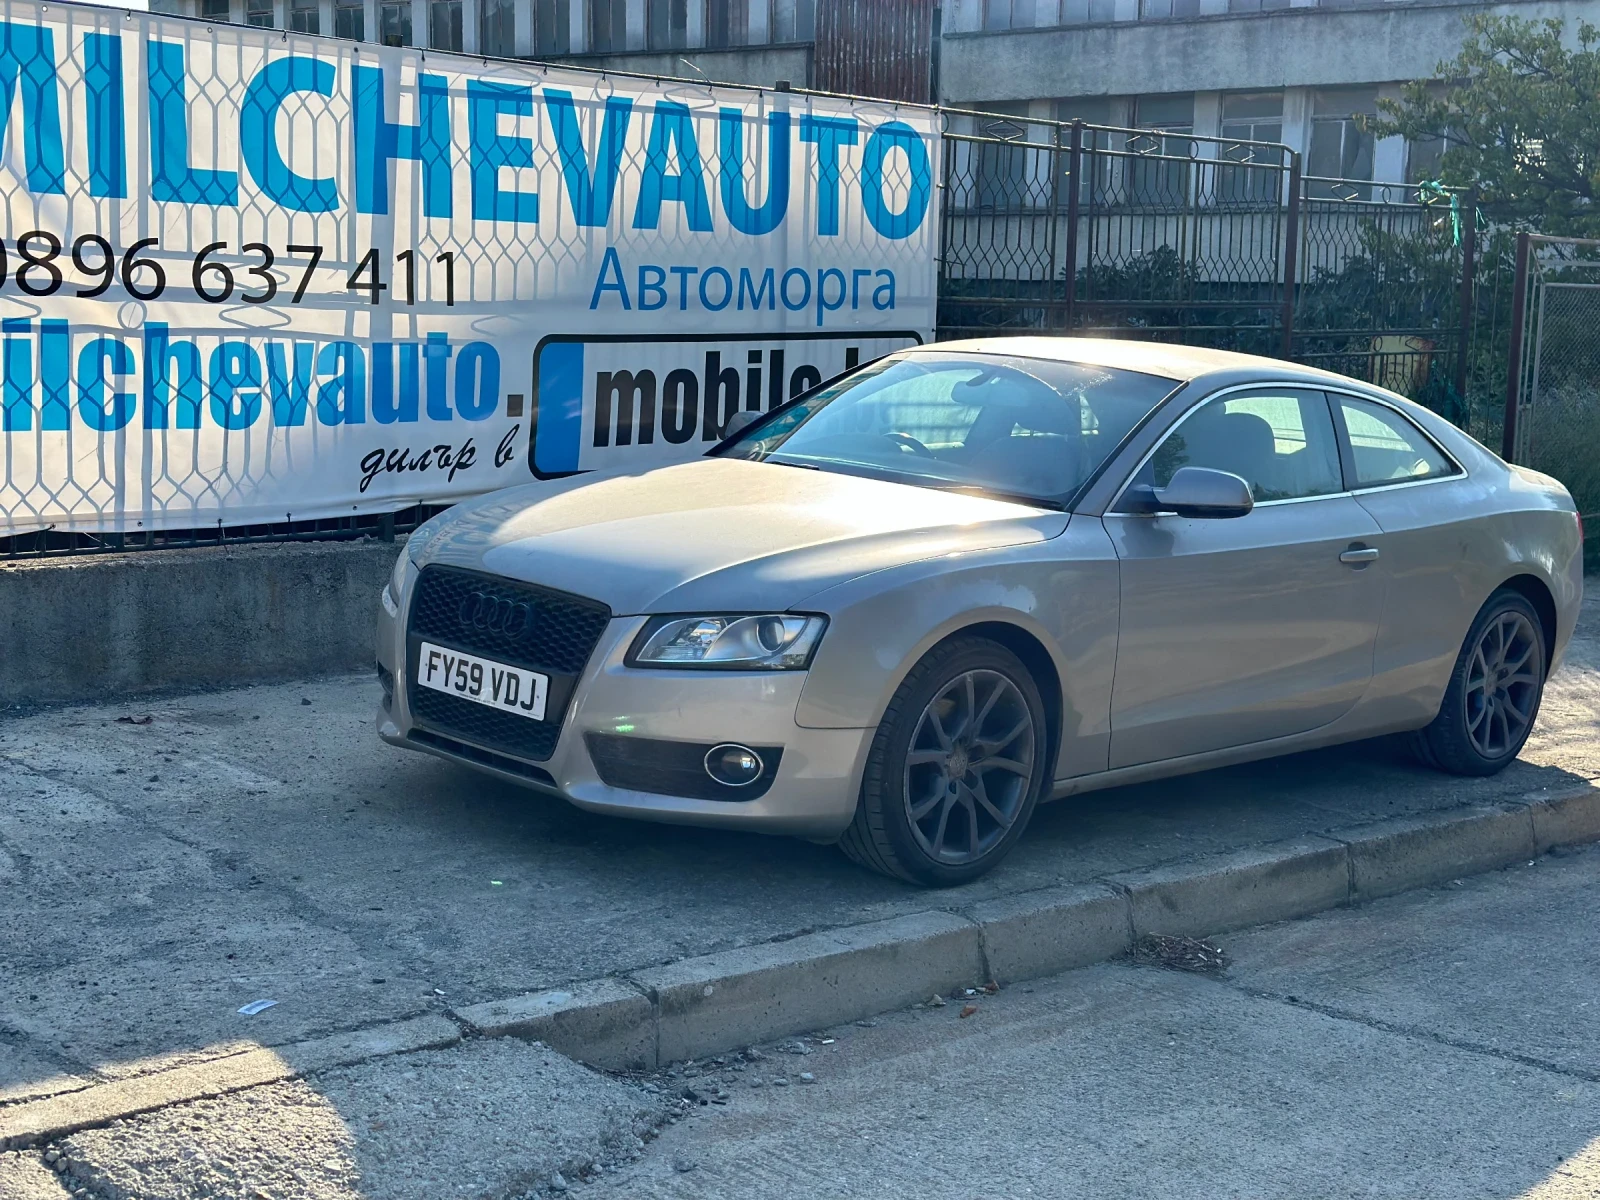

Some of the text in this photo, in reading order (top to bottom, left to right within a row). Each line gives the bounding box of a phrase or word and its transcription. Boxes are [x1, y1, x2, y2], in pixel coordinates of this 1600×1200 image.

[0, 231, 456, 307] 896 637 411
[589, 247, 896, 327] Автоморга
[359, 423, 520, 493] дилър в
[427, 650, 537, 711] FY59 VDJ
